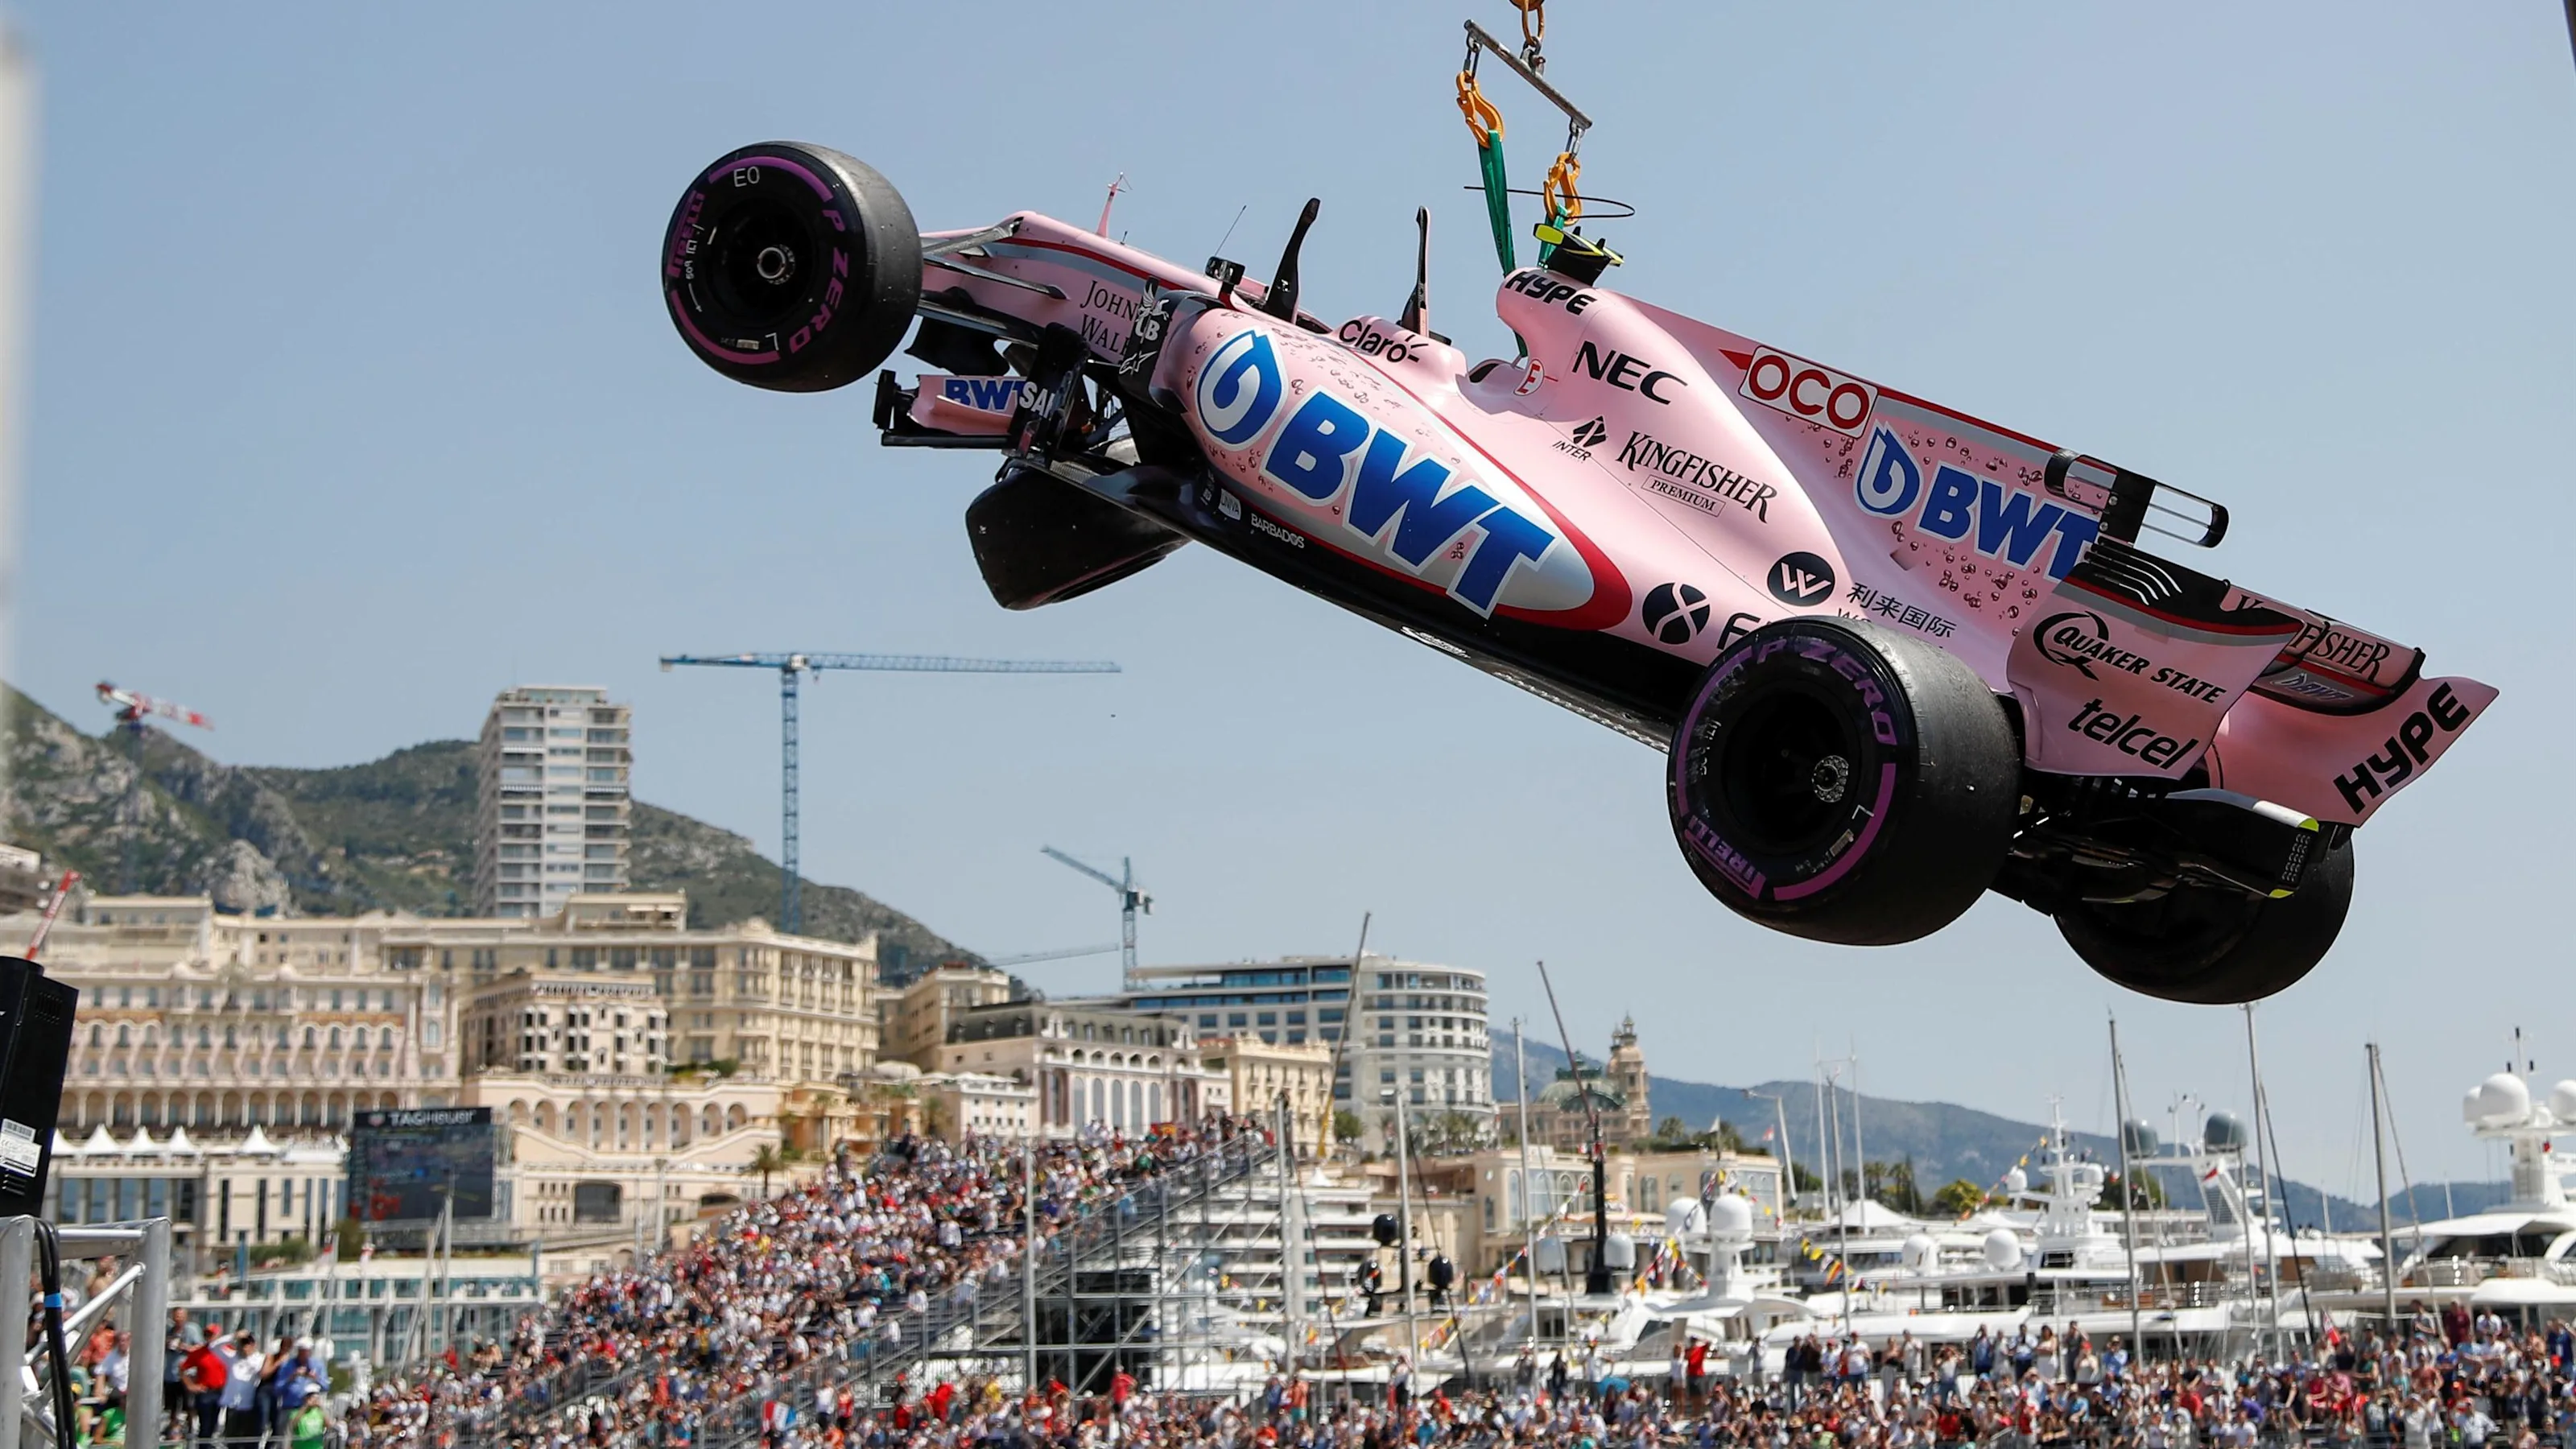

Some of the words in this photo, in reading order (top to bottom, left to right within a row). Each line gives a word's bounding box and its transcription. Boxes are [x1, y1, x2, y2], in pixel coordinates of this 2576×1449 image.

[789, 247, 848, 354] ZERO
[1080, 280, 1138, 321] JOHN
[1505, 270, 1598, 316] HYPE
[1339, 320, 1407, 363] Claro
[1571, 341, 1687, 405] NEC
[1748, 354, 1868, 430] OCO
[1552, 440, 1591, 461] INTER
[1616, 431, 1778, 523] KINGFISHER
[1264, 390, 1556, 618] BWT
[1649, 479, 1719, 512] PREMIUM
[1919, 464, 2100, 581] BWT
[1251, 513, 1305, 549] BARBADOS
[1846, 582, 1957, 638] 利来国际
[2054, 626, 2150, 675] QUAKER
[2150, 667, 2227, 704] STATE
[2067, 698, 2199, 770] telcel
[2333, 682, 2470, 814] HYPE
